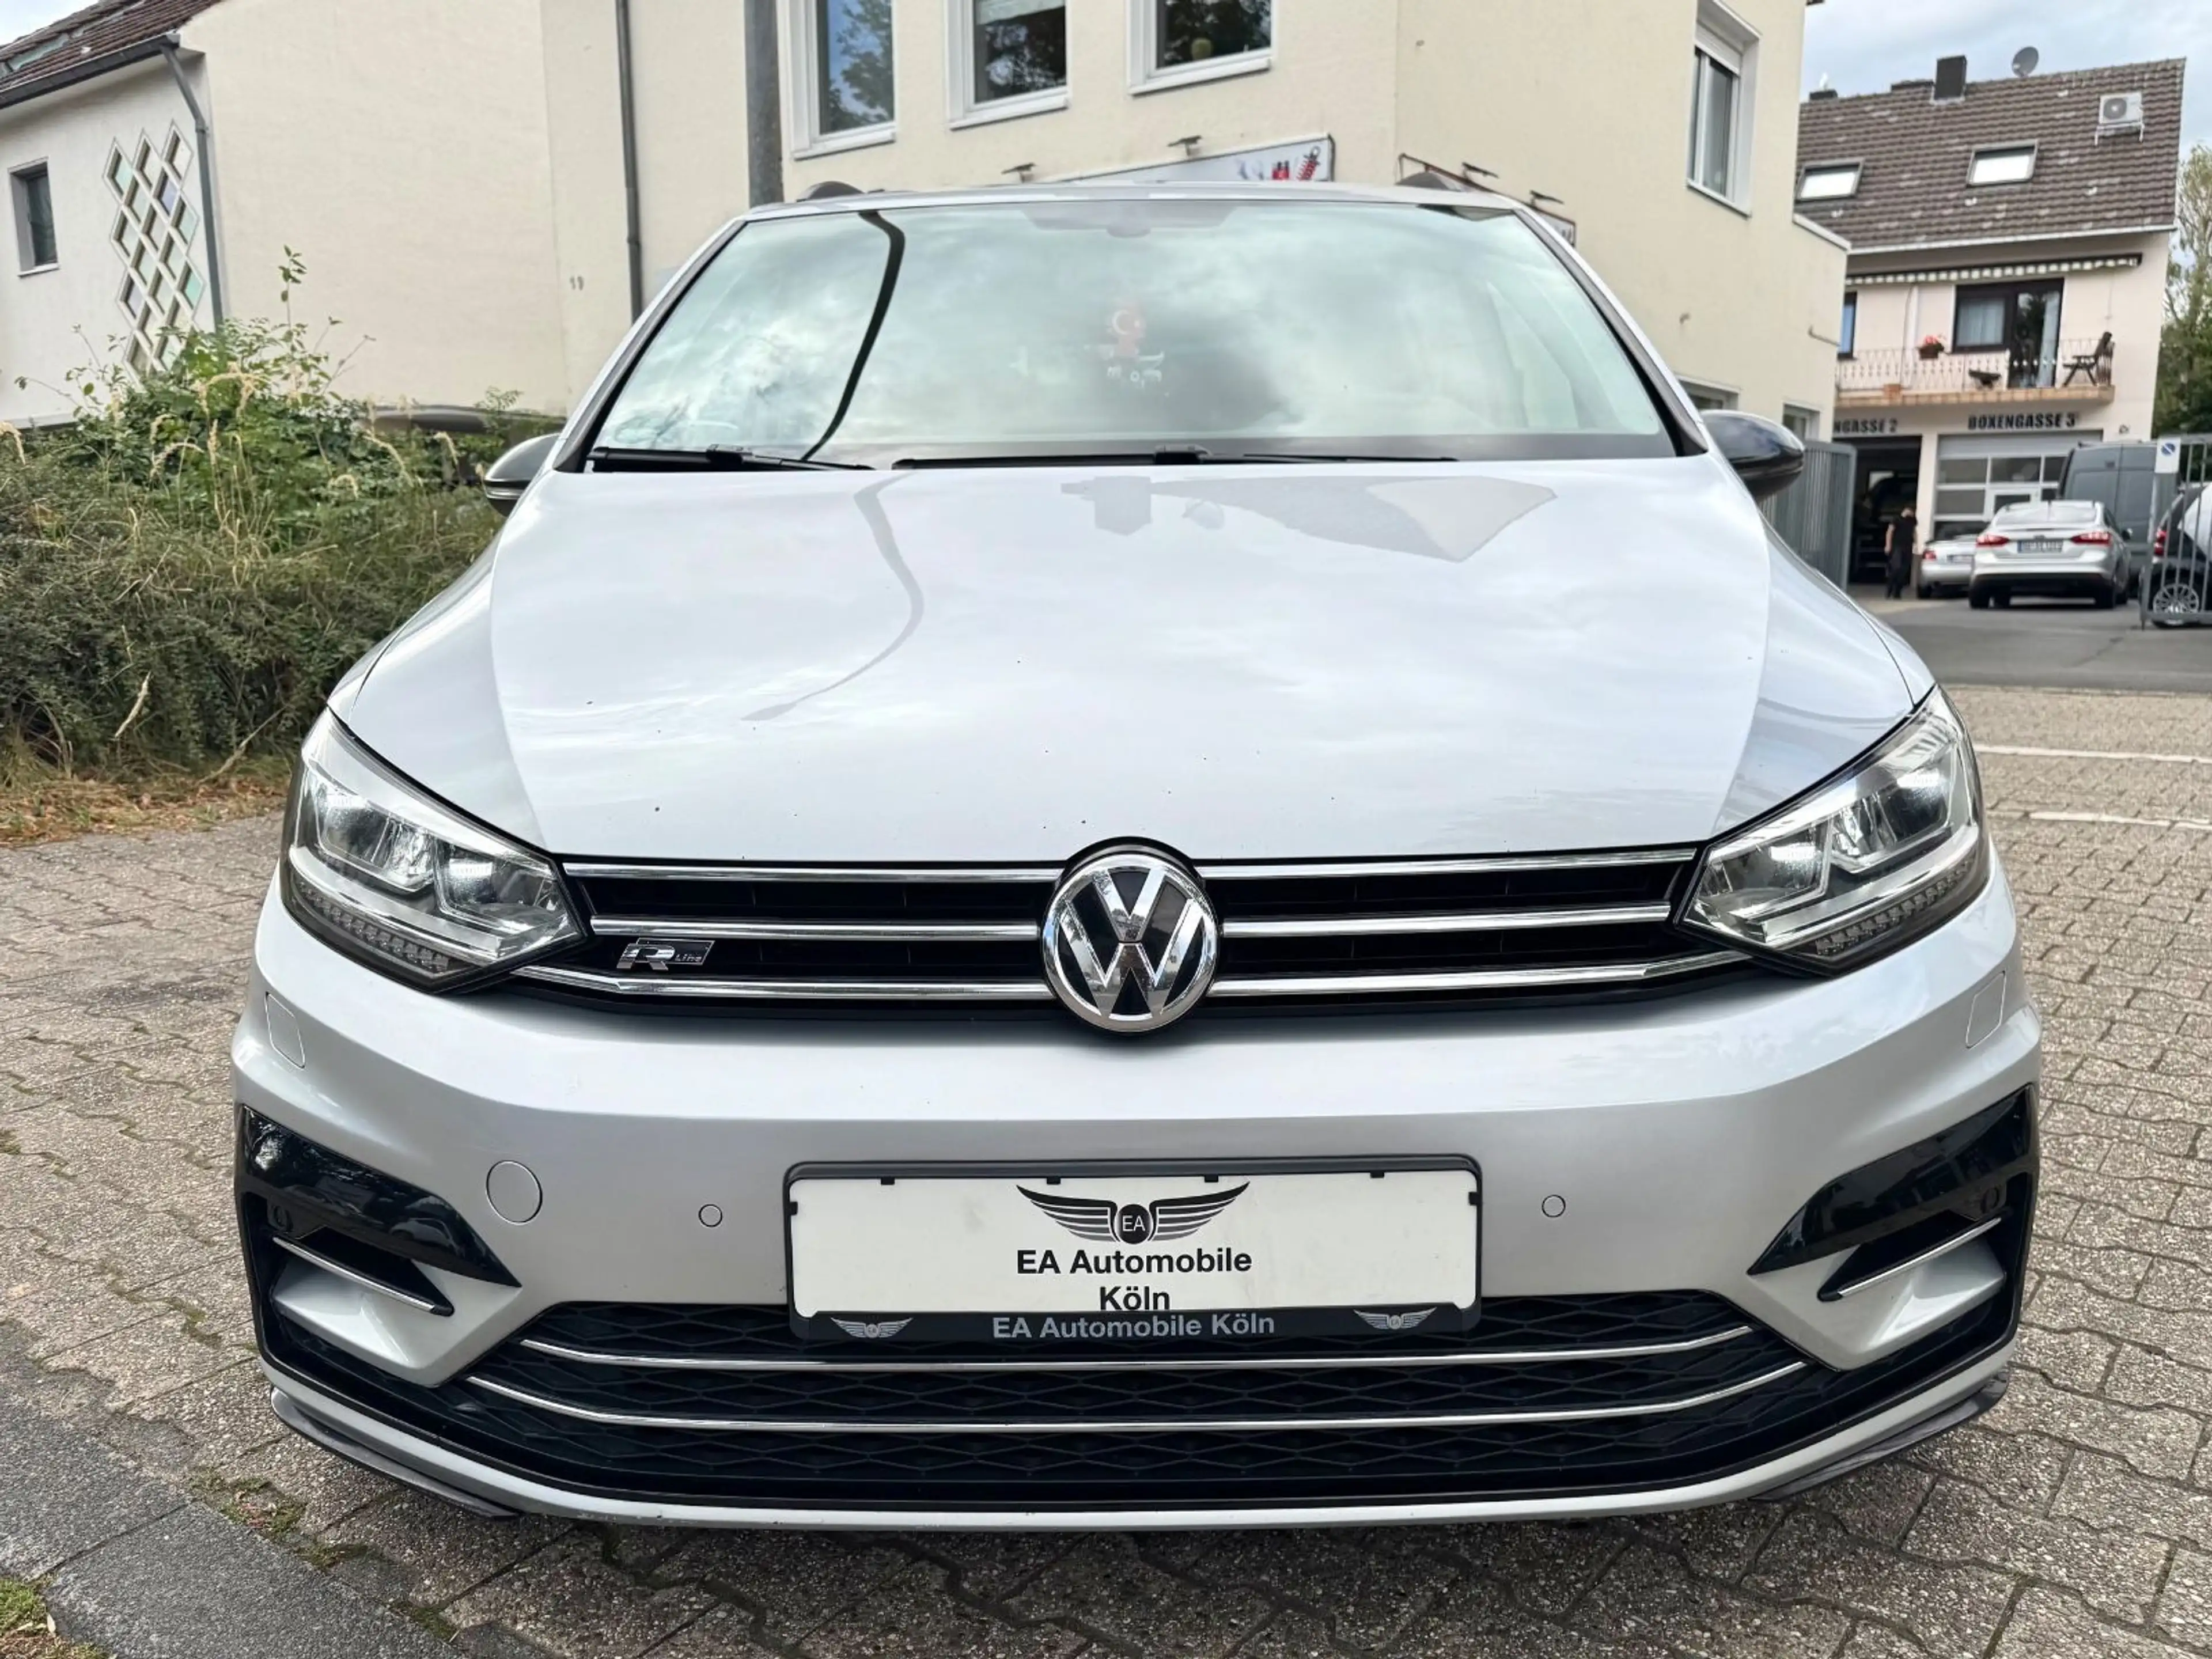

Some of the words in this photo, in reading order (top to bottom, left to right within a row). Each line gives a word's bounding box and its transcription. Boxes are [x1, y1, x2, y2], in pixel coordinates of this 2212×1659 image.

[1968, 412, 2062, 430] BOXENGASSE
[2067, 411, 2077, 427] 3
[1052, 861, 1210, 1023] VW
[616, 943, 675, 970] R
[1122, 1215, 1145, 1232] EA
[1017, 1249, 1060, 1274] EA
[1070, 1248, 1252, 1274] Automobile
[1100, 1286, 1170, 1311] Köln
[993, 1317, 1032, 1338] EA
[1039, 1315, 1202, 1338] Automobile
[1212, 1313, 1274, 1335] Köln
